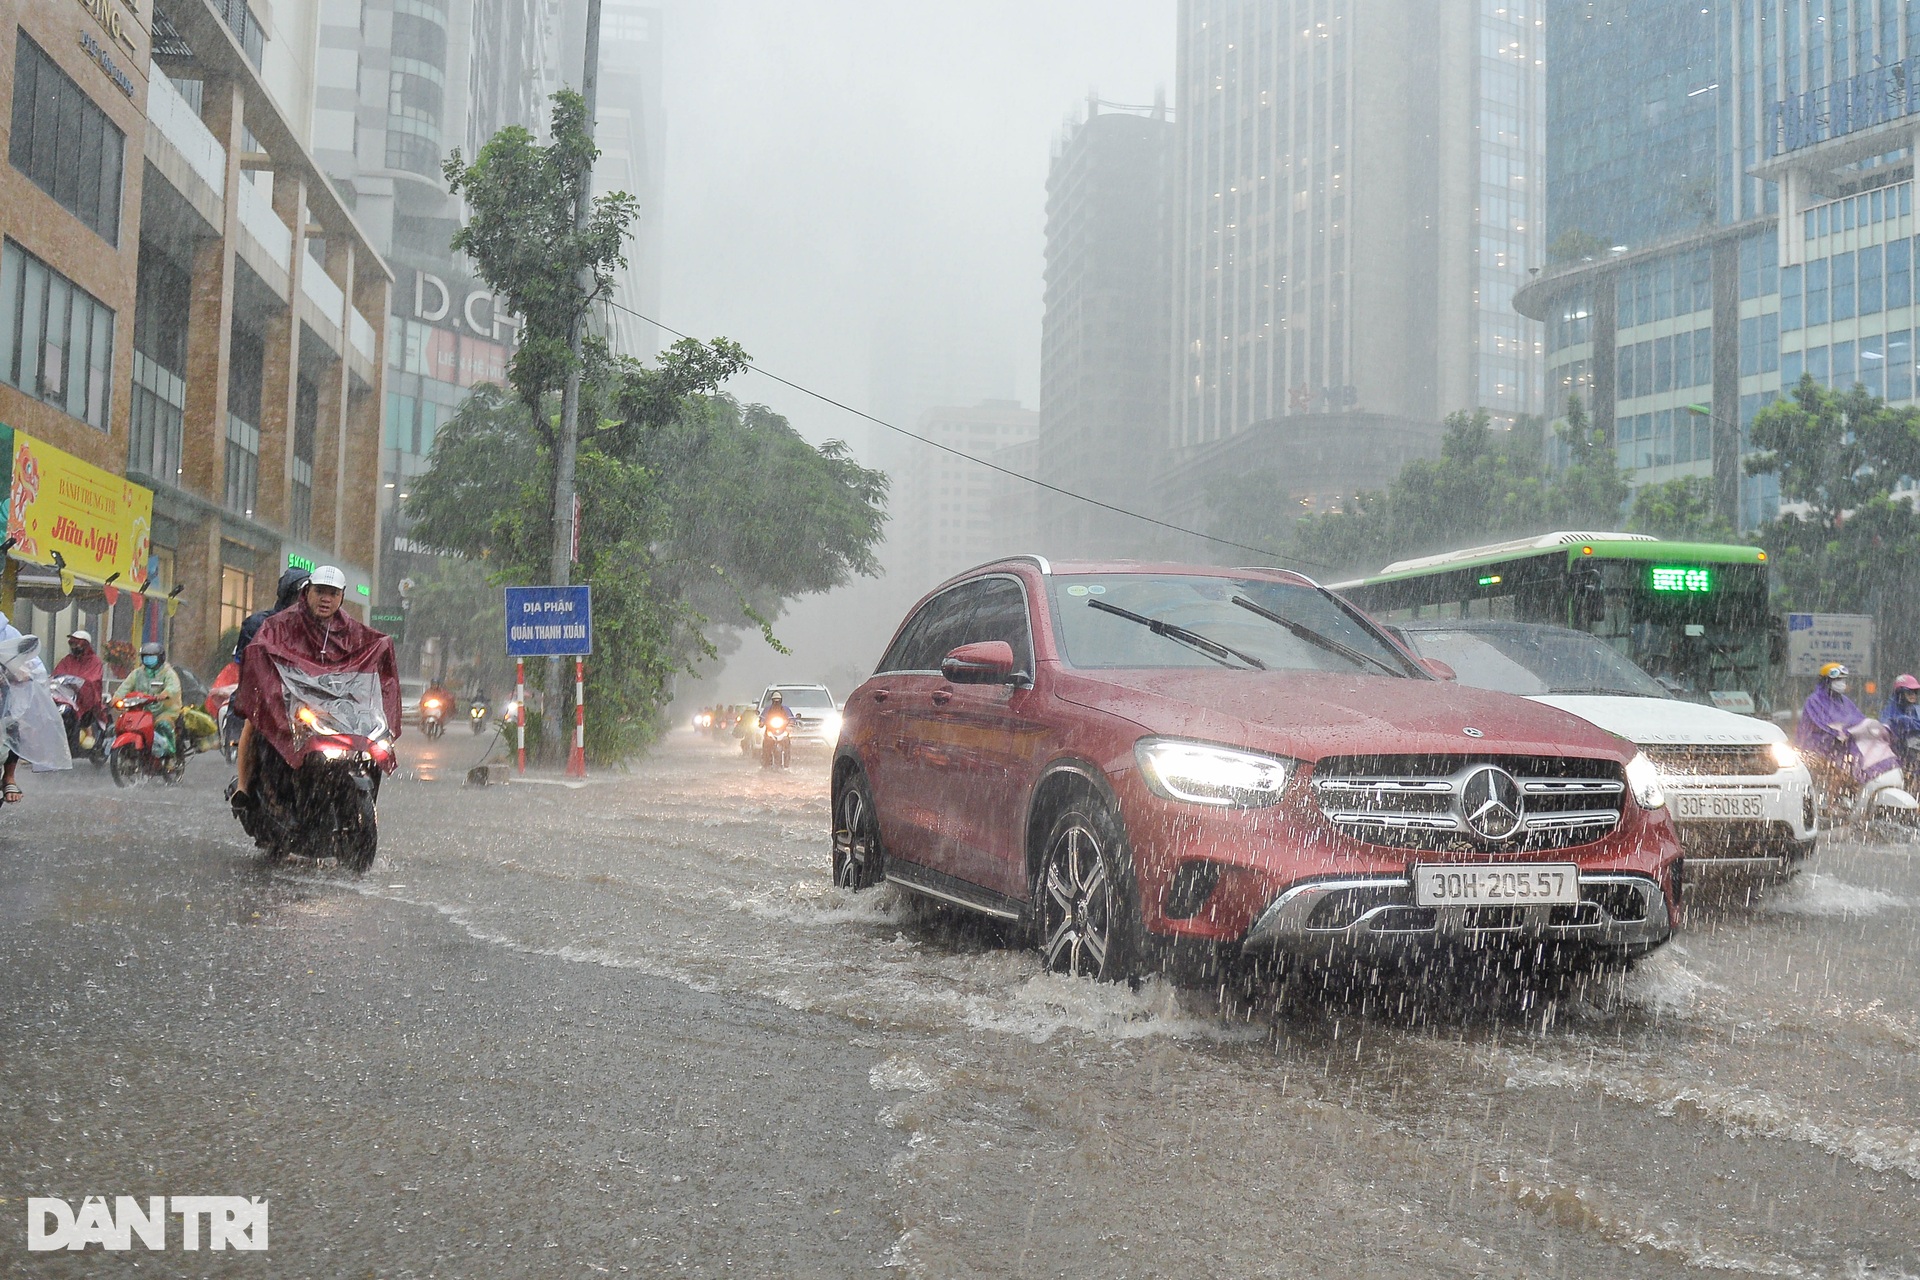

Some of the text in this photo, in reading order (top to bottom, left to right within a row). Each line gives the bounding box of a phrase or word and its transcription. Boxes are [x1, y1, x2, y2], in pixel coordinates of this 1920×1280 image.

[59, 476, 81, 502] BÁNH
[81, 487, 104, 512] TRUNG
[52, 515, 119, 565] Hữu Nghị
[523, 599, 573, 616] ĐỊA PHẬN
[511, 621, 585, 643] QUẬN THANH XUÂN
[1681, 796, 1763, 816] 30F-608.85
[1432, 872, 1565, 899] 30H-205.57
